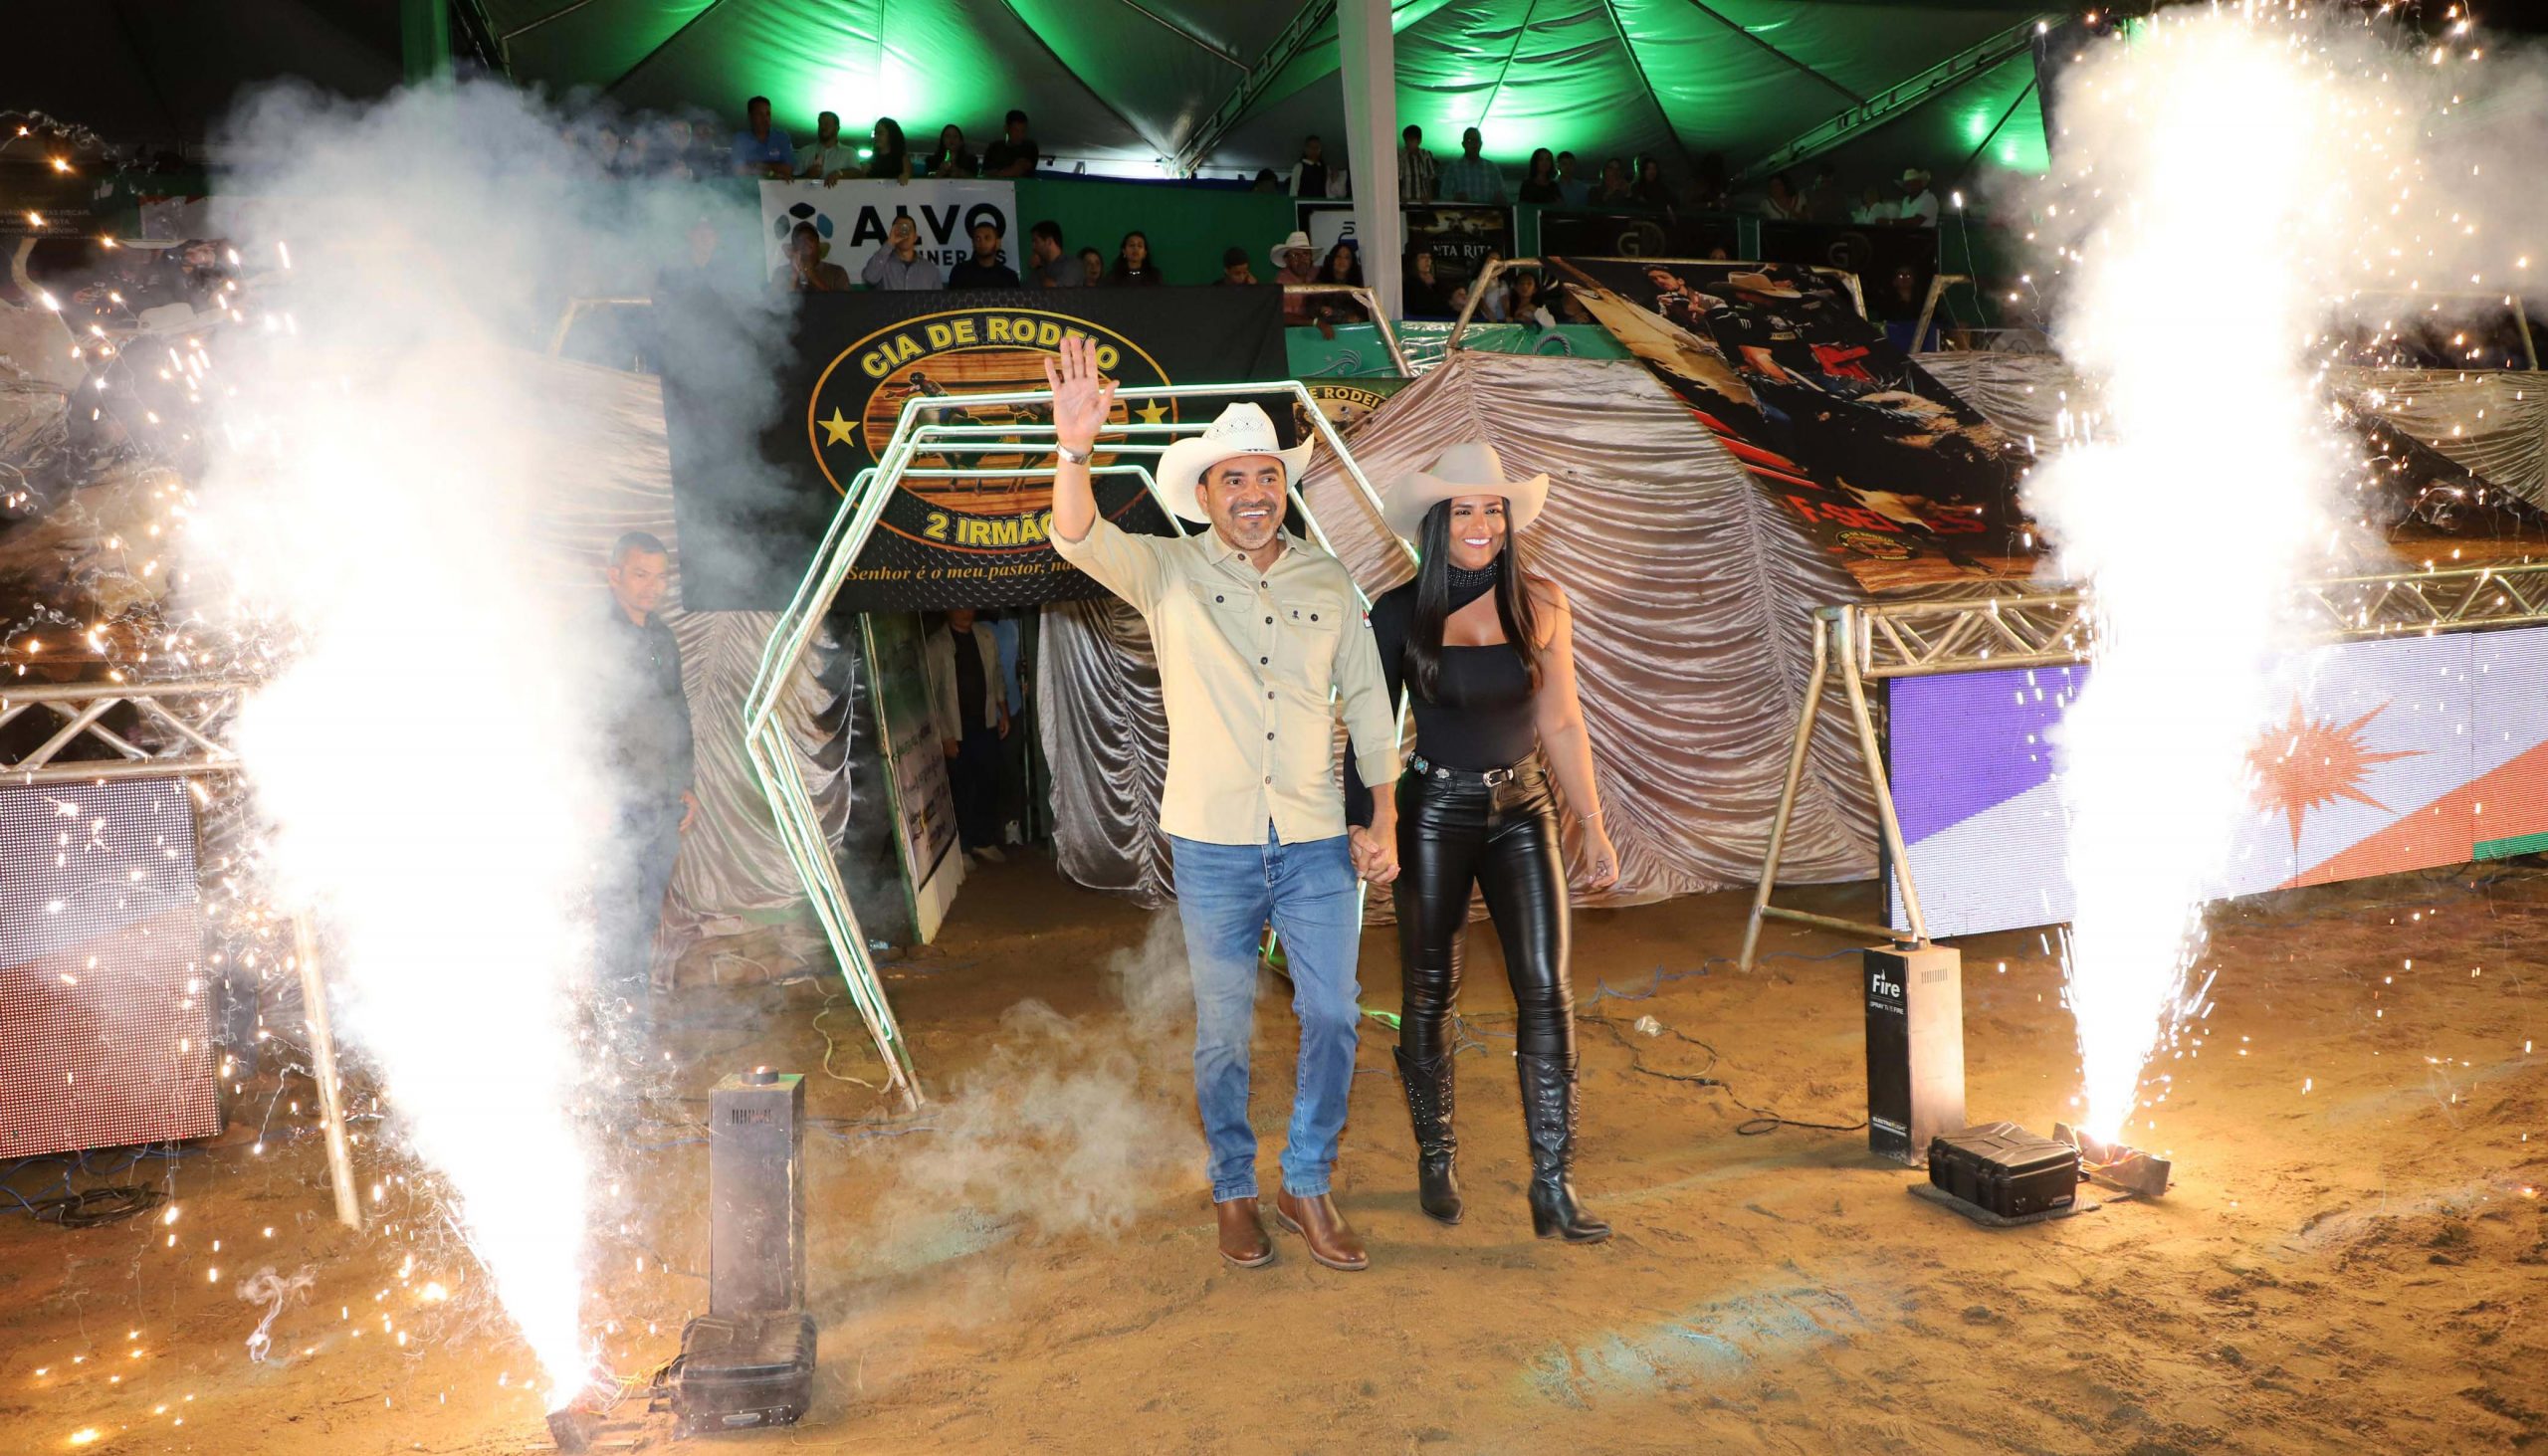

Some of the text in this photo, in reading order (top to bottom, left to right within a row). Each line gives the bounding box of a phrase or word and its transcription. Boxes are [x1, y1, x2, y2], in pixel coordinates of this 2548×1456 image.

[861, 316, 1121, 378] CIA DE RODO
[924, 512, 950, 539] 2
[846, 564, 911, 581] Senhor
[916, 564, 927, 580] é
[931, 568, 943, 579] o
[947, 566, 983, 579] meu
[1872, 969, 1901, 998] Fire
